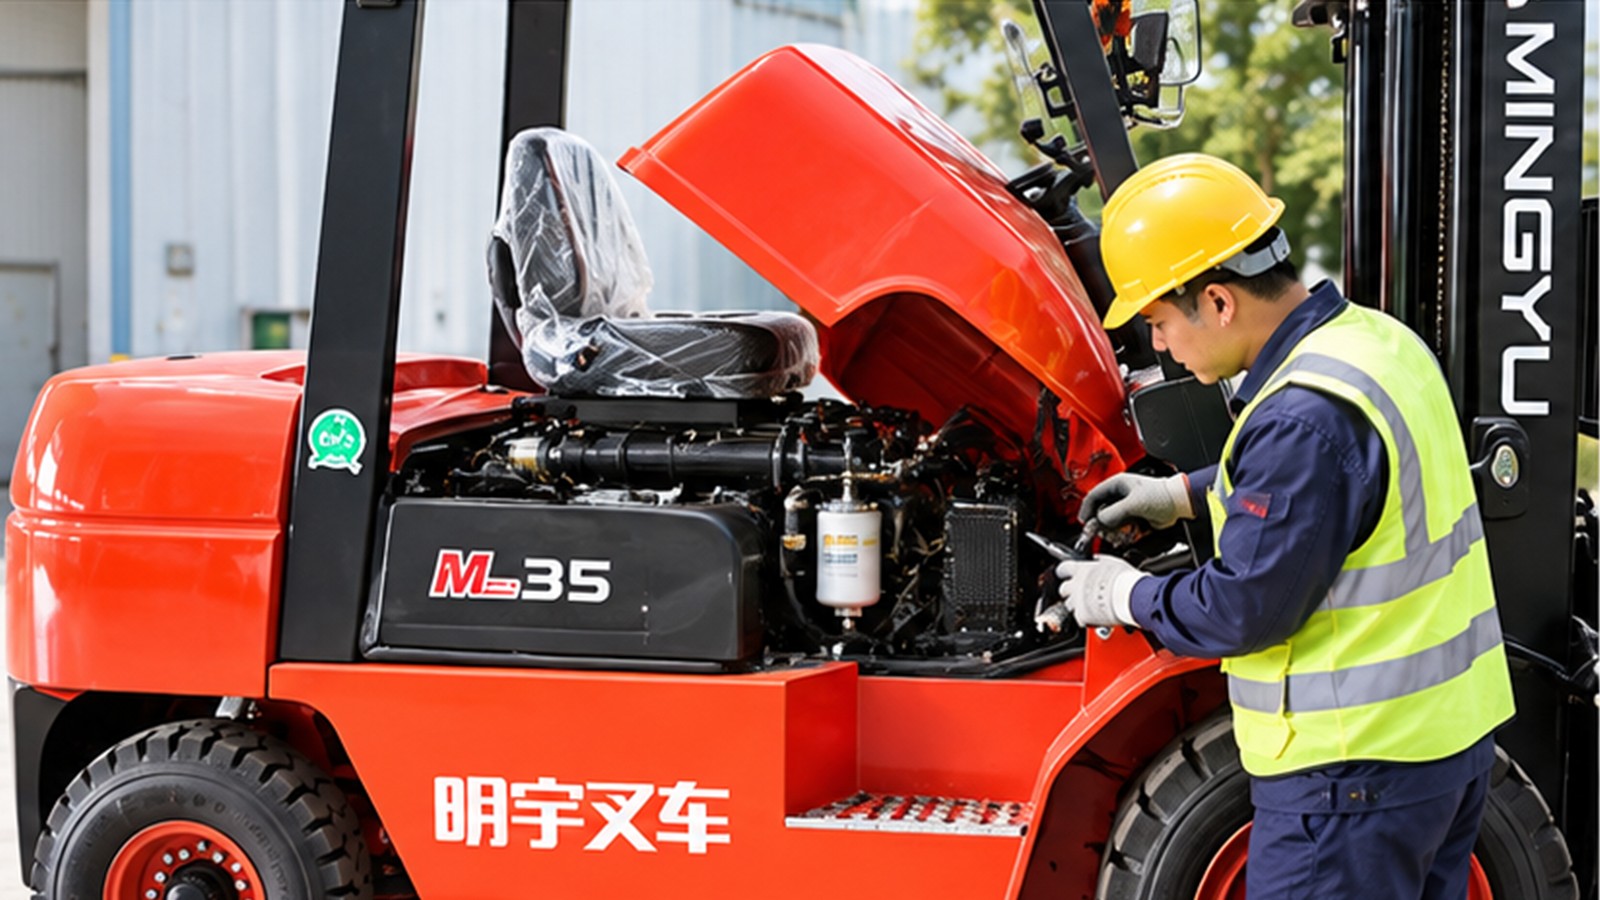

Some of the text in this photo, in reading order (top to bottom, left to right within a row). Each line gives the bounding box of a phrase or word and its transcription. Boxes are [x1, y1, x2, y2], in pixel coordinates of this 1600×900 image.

[1501, 22, 1555, 416] MINGYU
[434, 776, 731, 854] 明宇叉车
